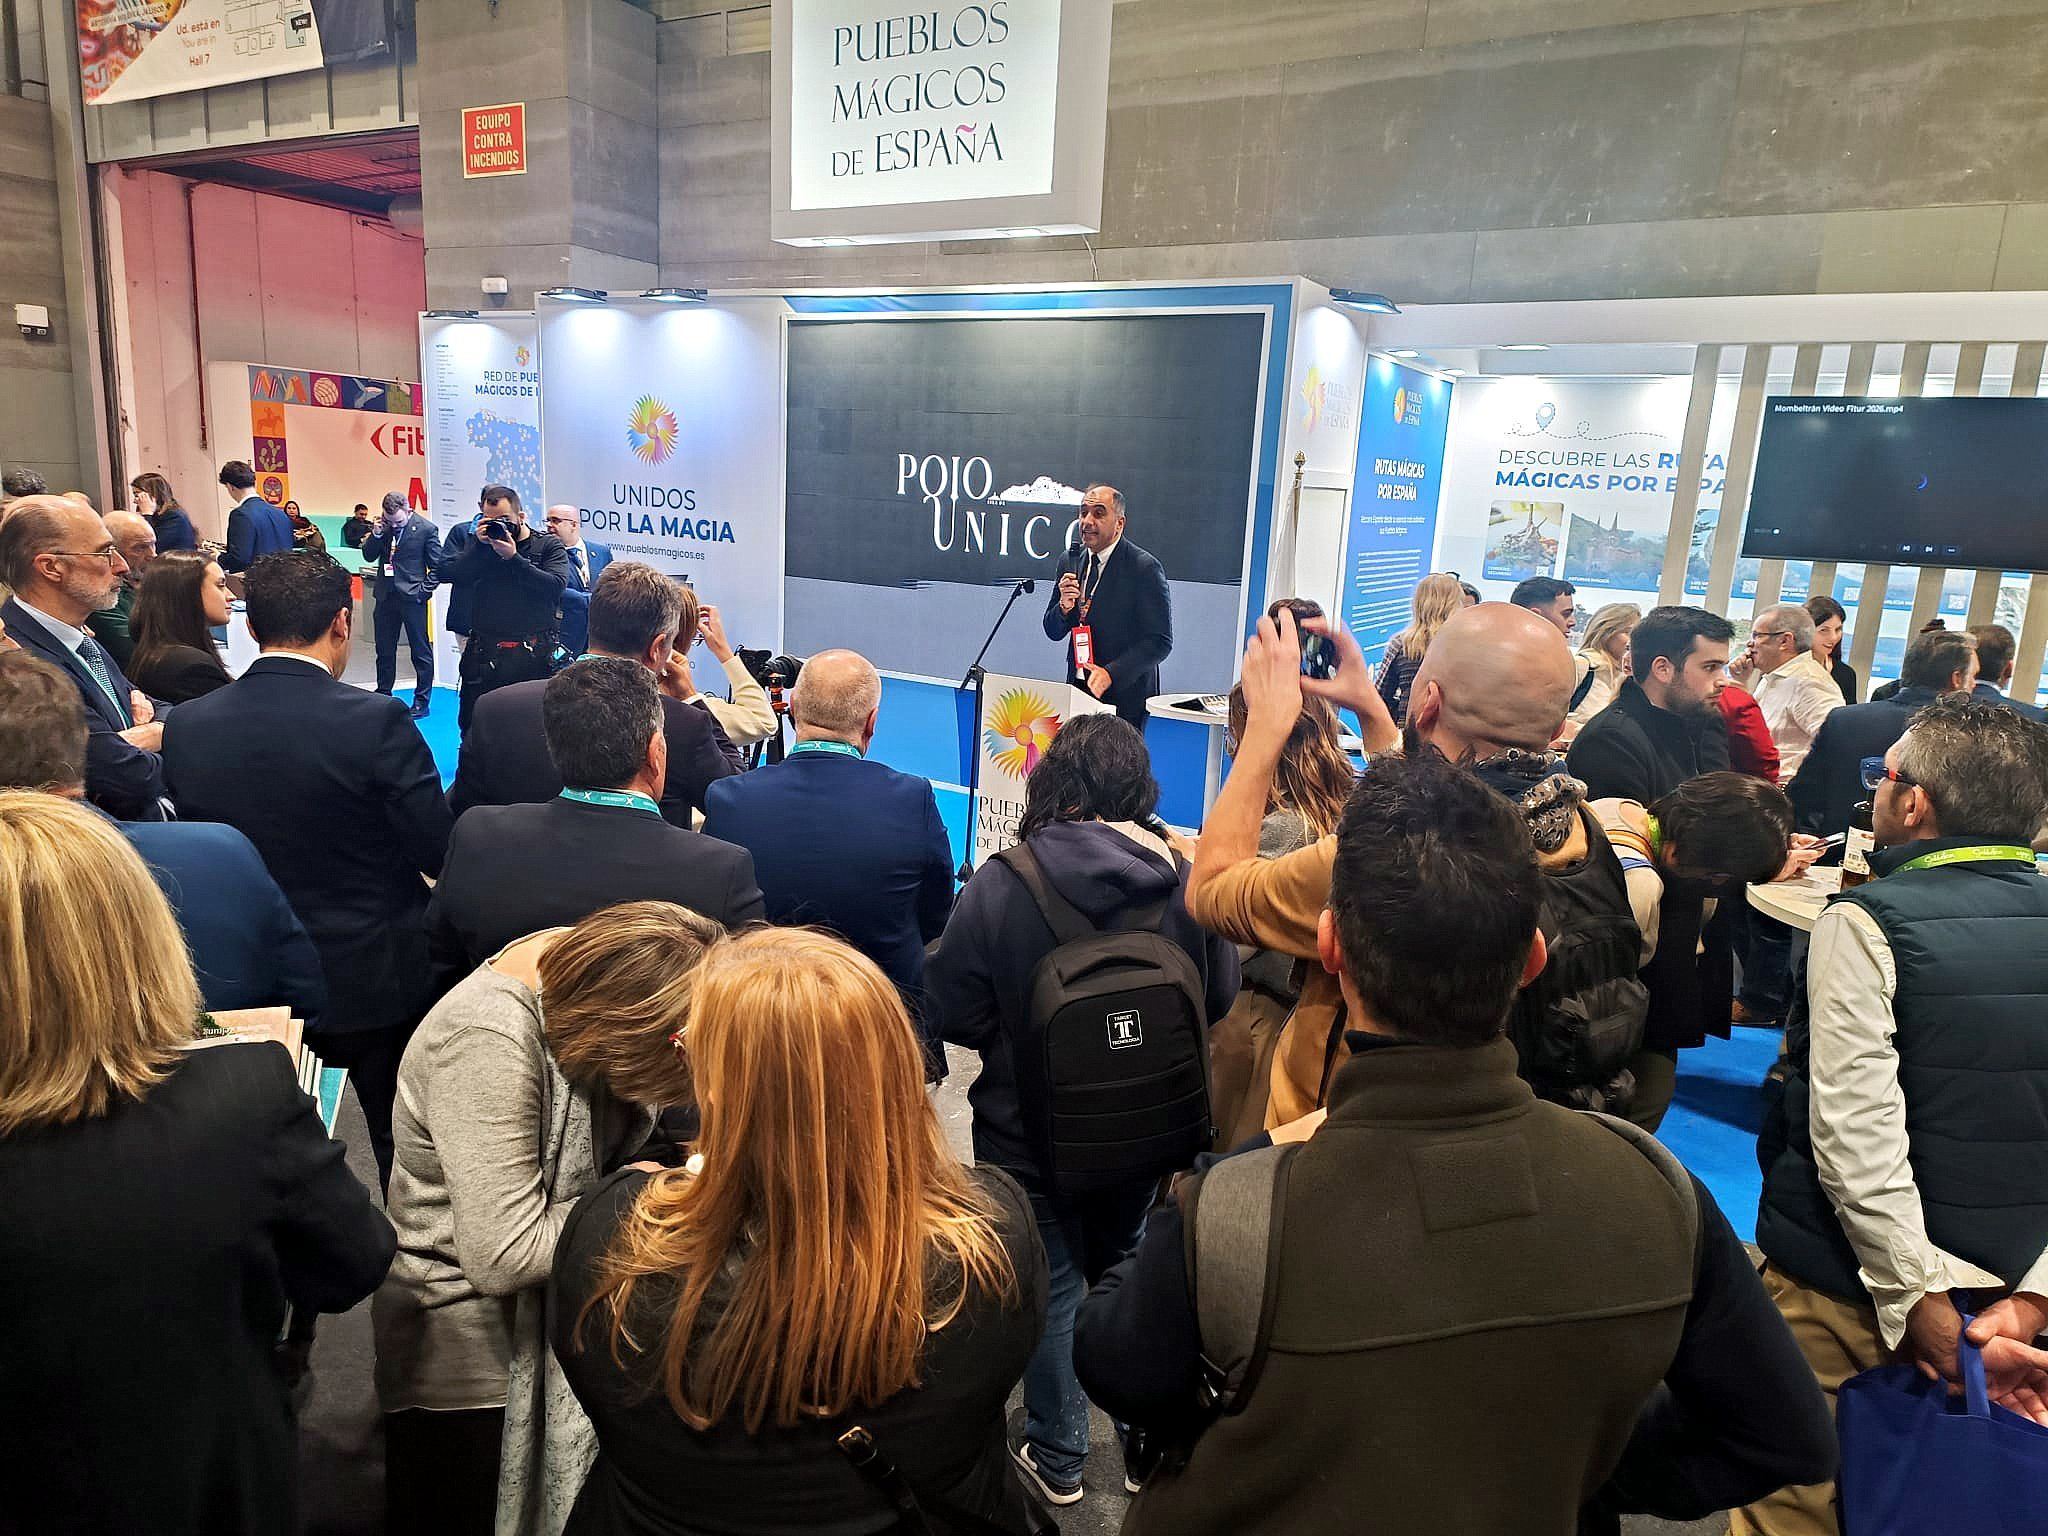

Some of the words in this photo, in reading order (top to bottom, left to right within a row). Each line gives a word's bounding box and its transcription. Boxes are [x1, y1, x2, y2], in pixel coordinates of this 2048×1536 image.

[176, 23, 189, 35] Ud.
[190, 19, 209, 34] está
[210, 18, 221, 30] en
[833, 1, 1009, 67] PUEBLOS
[189, 55, 204, 67] Hall
[204, 53, 211, 64] 7
[832, 62, 1006, 123] MÁGICOS
[475, 112, 511, 130] EQUIPO
[473, 131, 513, 150] CONTRA
[832, 150, 864, 177] DE
[876, 121, 1004, 173] ESPAÑA
[469, 150, 520, 169] INCENDIOS
[484, 371, 503, 382] RED
[504, 371, 518, 383] DE
[520, 372, 539, 383] PUE
[475, 382, 518, 397] MÁGICOS
[520, 386, 533, 397] DE
[1822, 404, 1845, 413] Video
[1846, 404, 1866, 413] Fitur
[392, 425, 425, 456] Fit
[1374, 458, 1398, 476] RUTAS
[1397, 456, 1426, 479] MÁGICAS
[1498, 449, 1608, 467] DESCUBRE
[1613, 452, 1651, 469] LAS
[1495, 468, 1601, 490] MÁGICAS
[1606, 474, 1659, 493] POR
[612, 483, 696, 511] UNIDOS
[1377, 483, 1393, 500] POR
[1392, 481, 1417, 502] ESPAÑA
[579, 508, 621, 532] POR
[626, 512, 655, 536] LA
[660, 515, 736, 544] MAGIA
[606, 542, 705, 561] www.pueblosmagicos.es
[979, 796, 1025, 818] PUEB
[976, 836, 993, 850] DE
